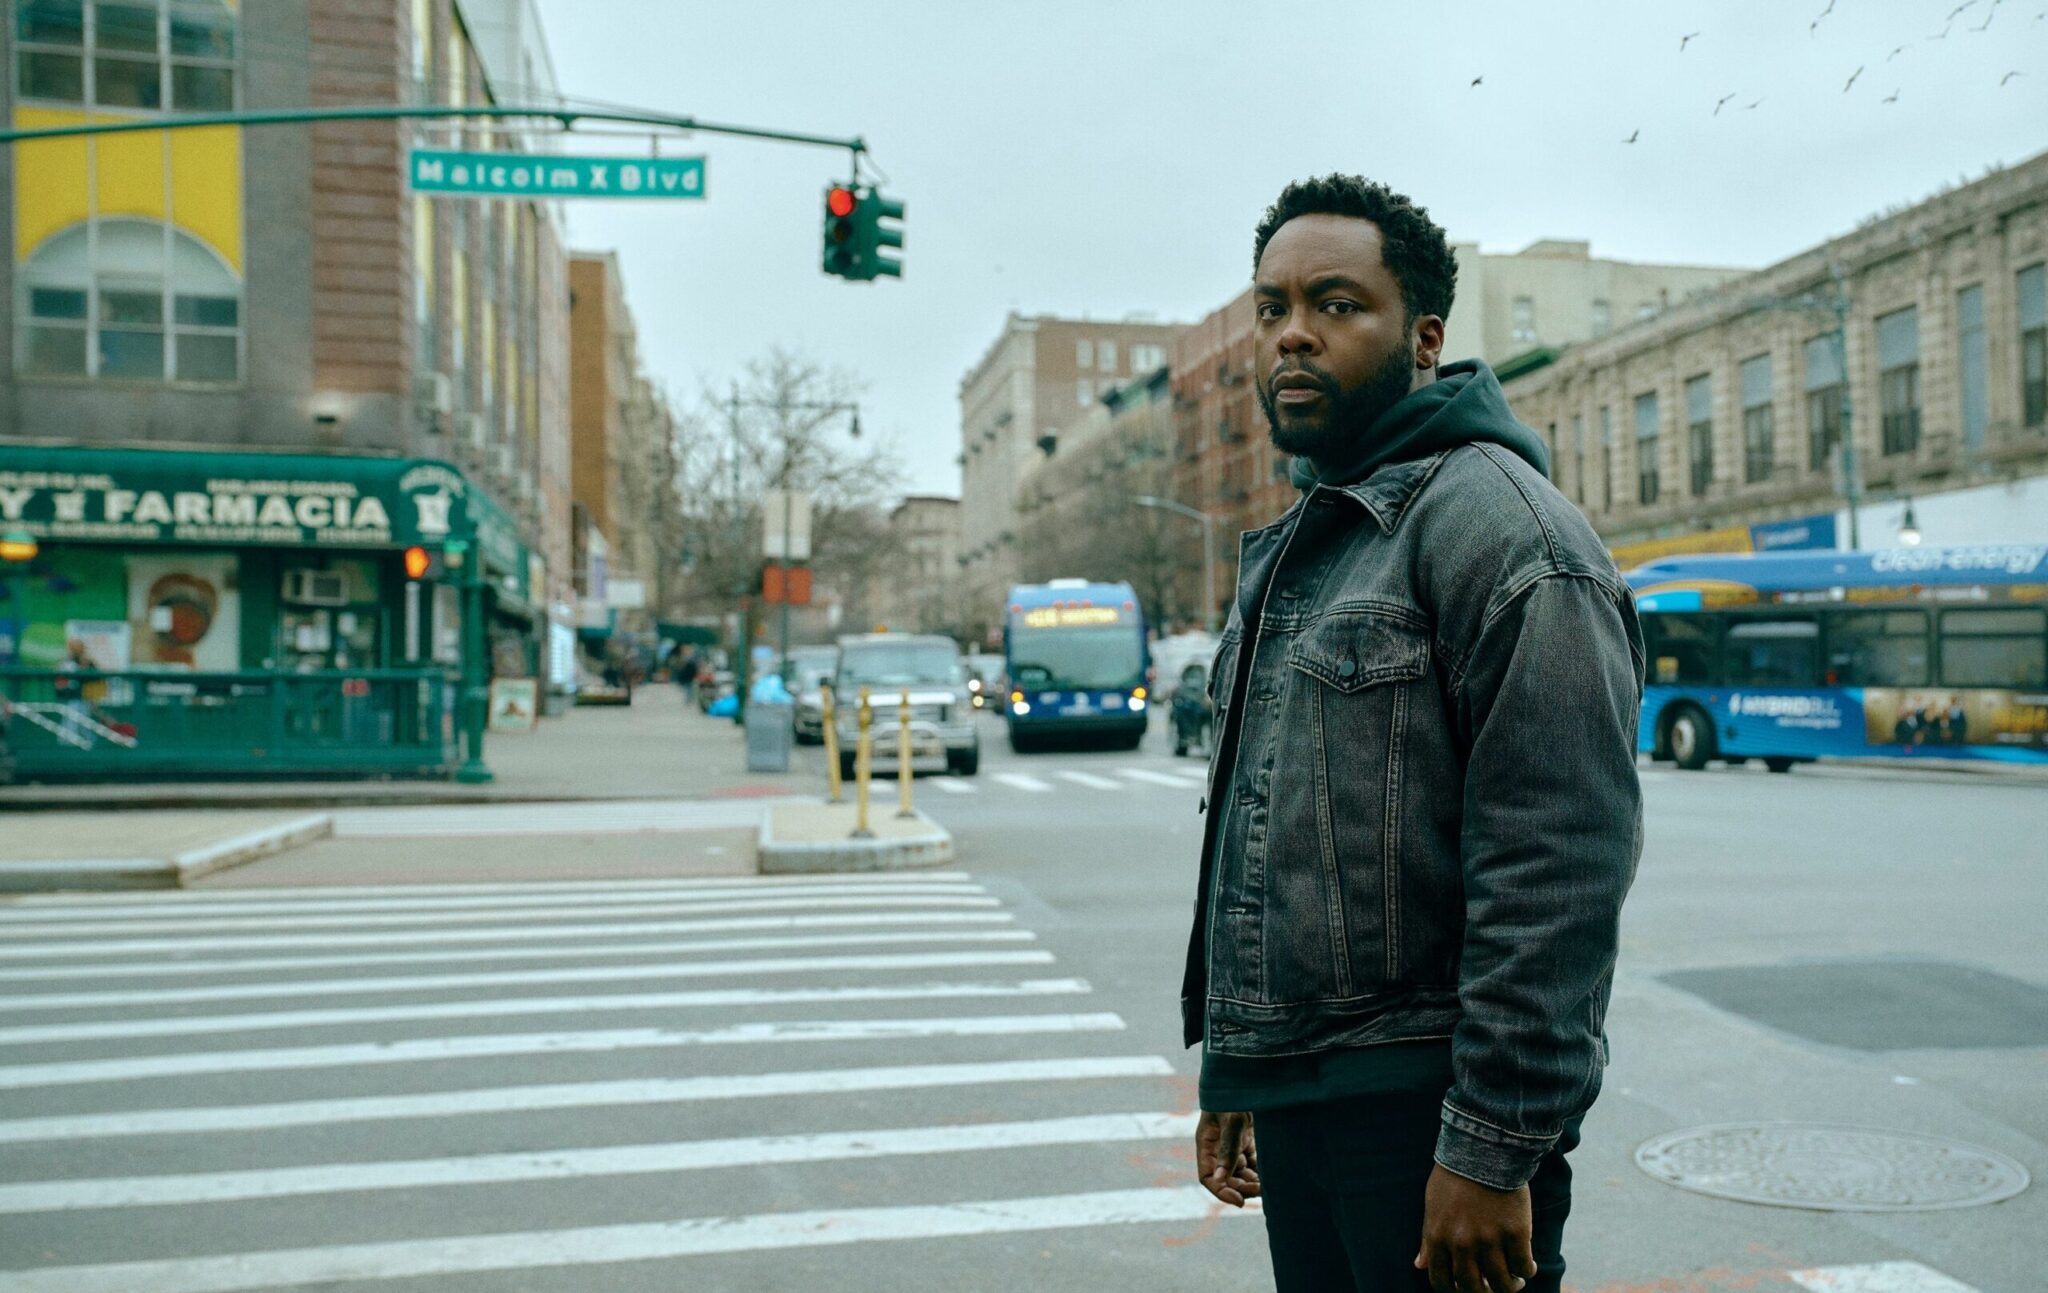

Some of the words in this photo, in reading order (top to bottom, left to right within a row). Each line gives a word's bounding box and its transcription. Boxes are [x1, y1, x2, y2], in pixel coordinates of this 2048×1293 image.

[417, 158, 579, 189] Malcolm
[589, 165, 609, 190] X
[619, 164, 700, 192] Blvd
[103, 489, 391, 529] FARMACIA
